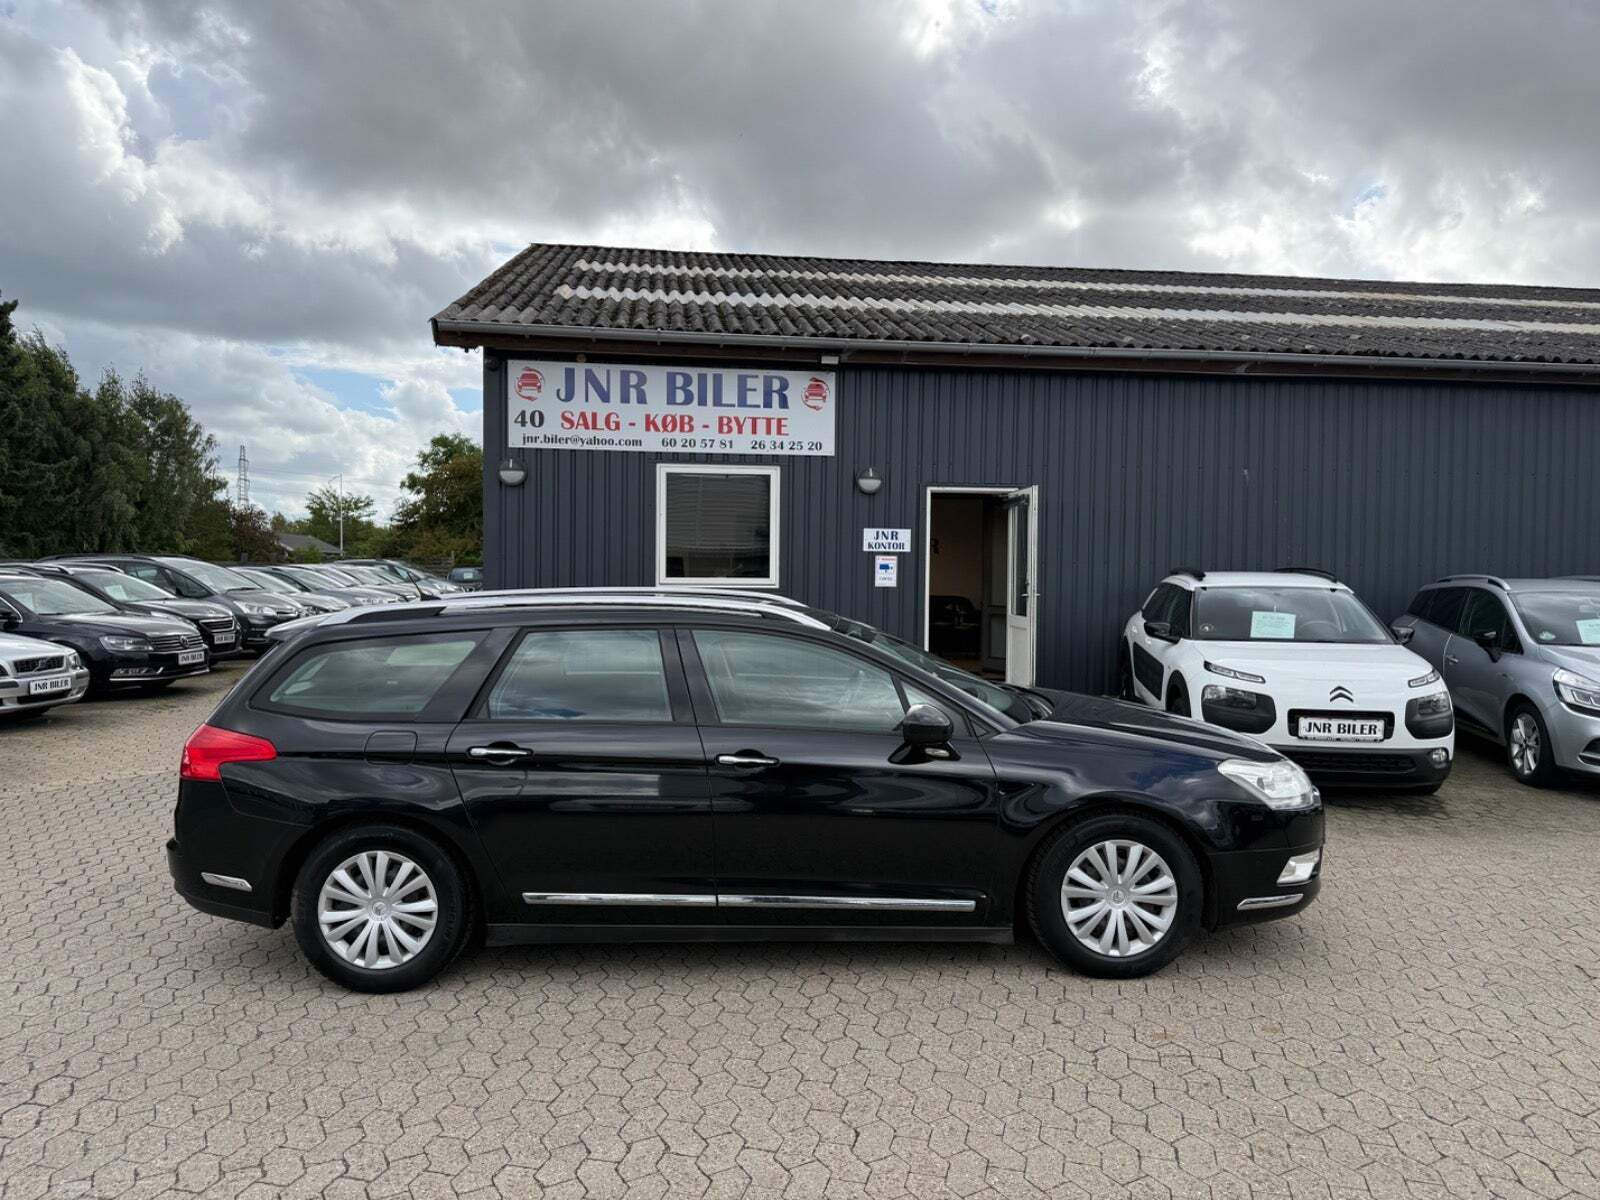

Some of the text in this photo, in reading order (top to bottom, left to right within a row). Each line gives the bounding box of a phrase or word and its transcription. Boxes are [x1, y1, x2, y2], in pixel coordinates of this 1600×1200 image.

[556, 367, 789, 409] JNR BILER
[513, 409, 545, 428] 40
[560, 410, 620, 431] SALG
[644, 412, 694, 434] KØB
[717, 414, 789, 436] BYTTE
[522, 433, 642, 447] jnr.biler@yahoo.com
[661, 437, 733, 449] 60 20 57 81
[750, 439, 822, 451] 26 34 25 20
[873, 530, 899, 540] JNR
[867, 541, 905, 550] KONTOR
[34, 679, 69, 691] JNR BILER
[1305, 721, 1378, 735] JNR BILER
